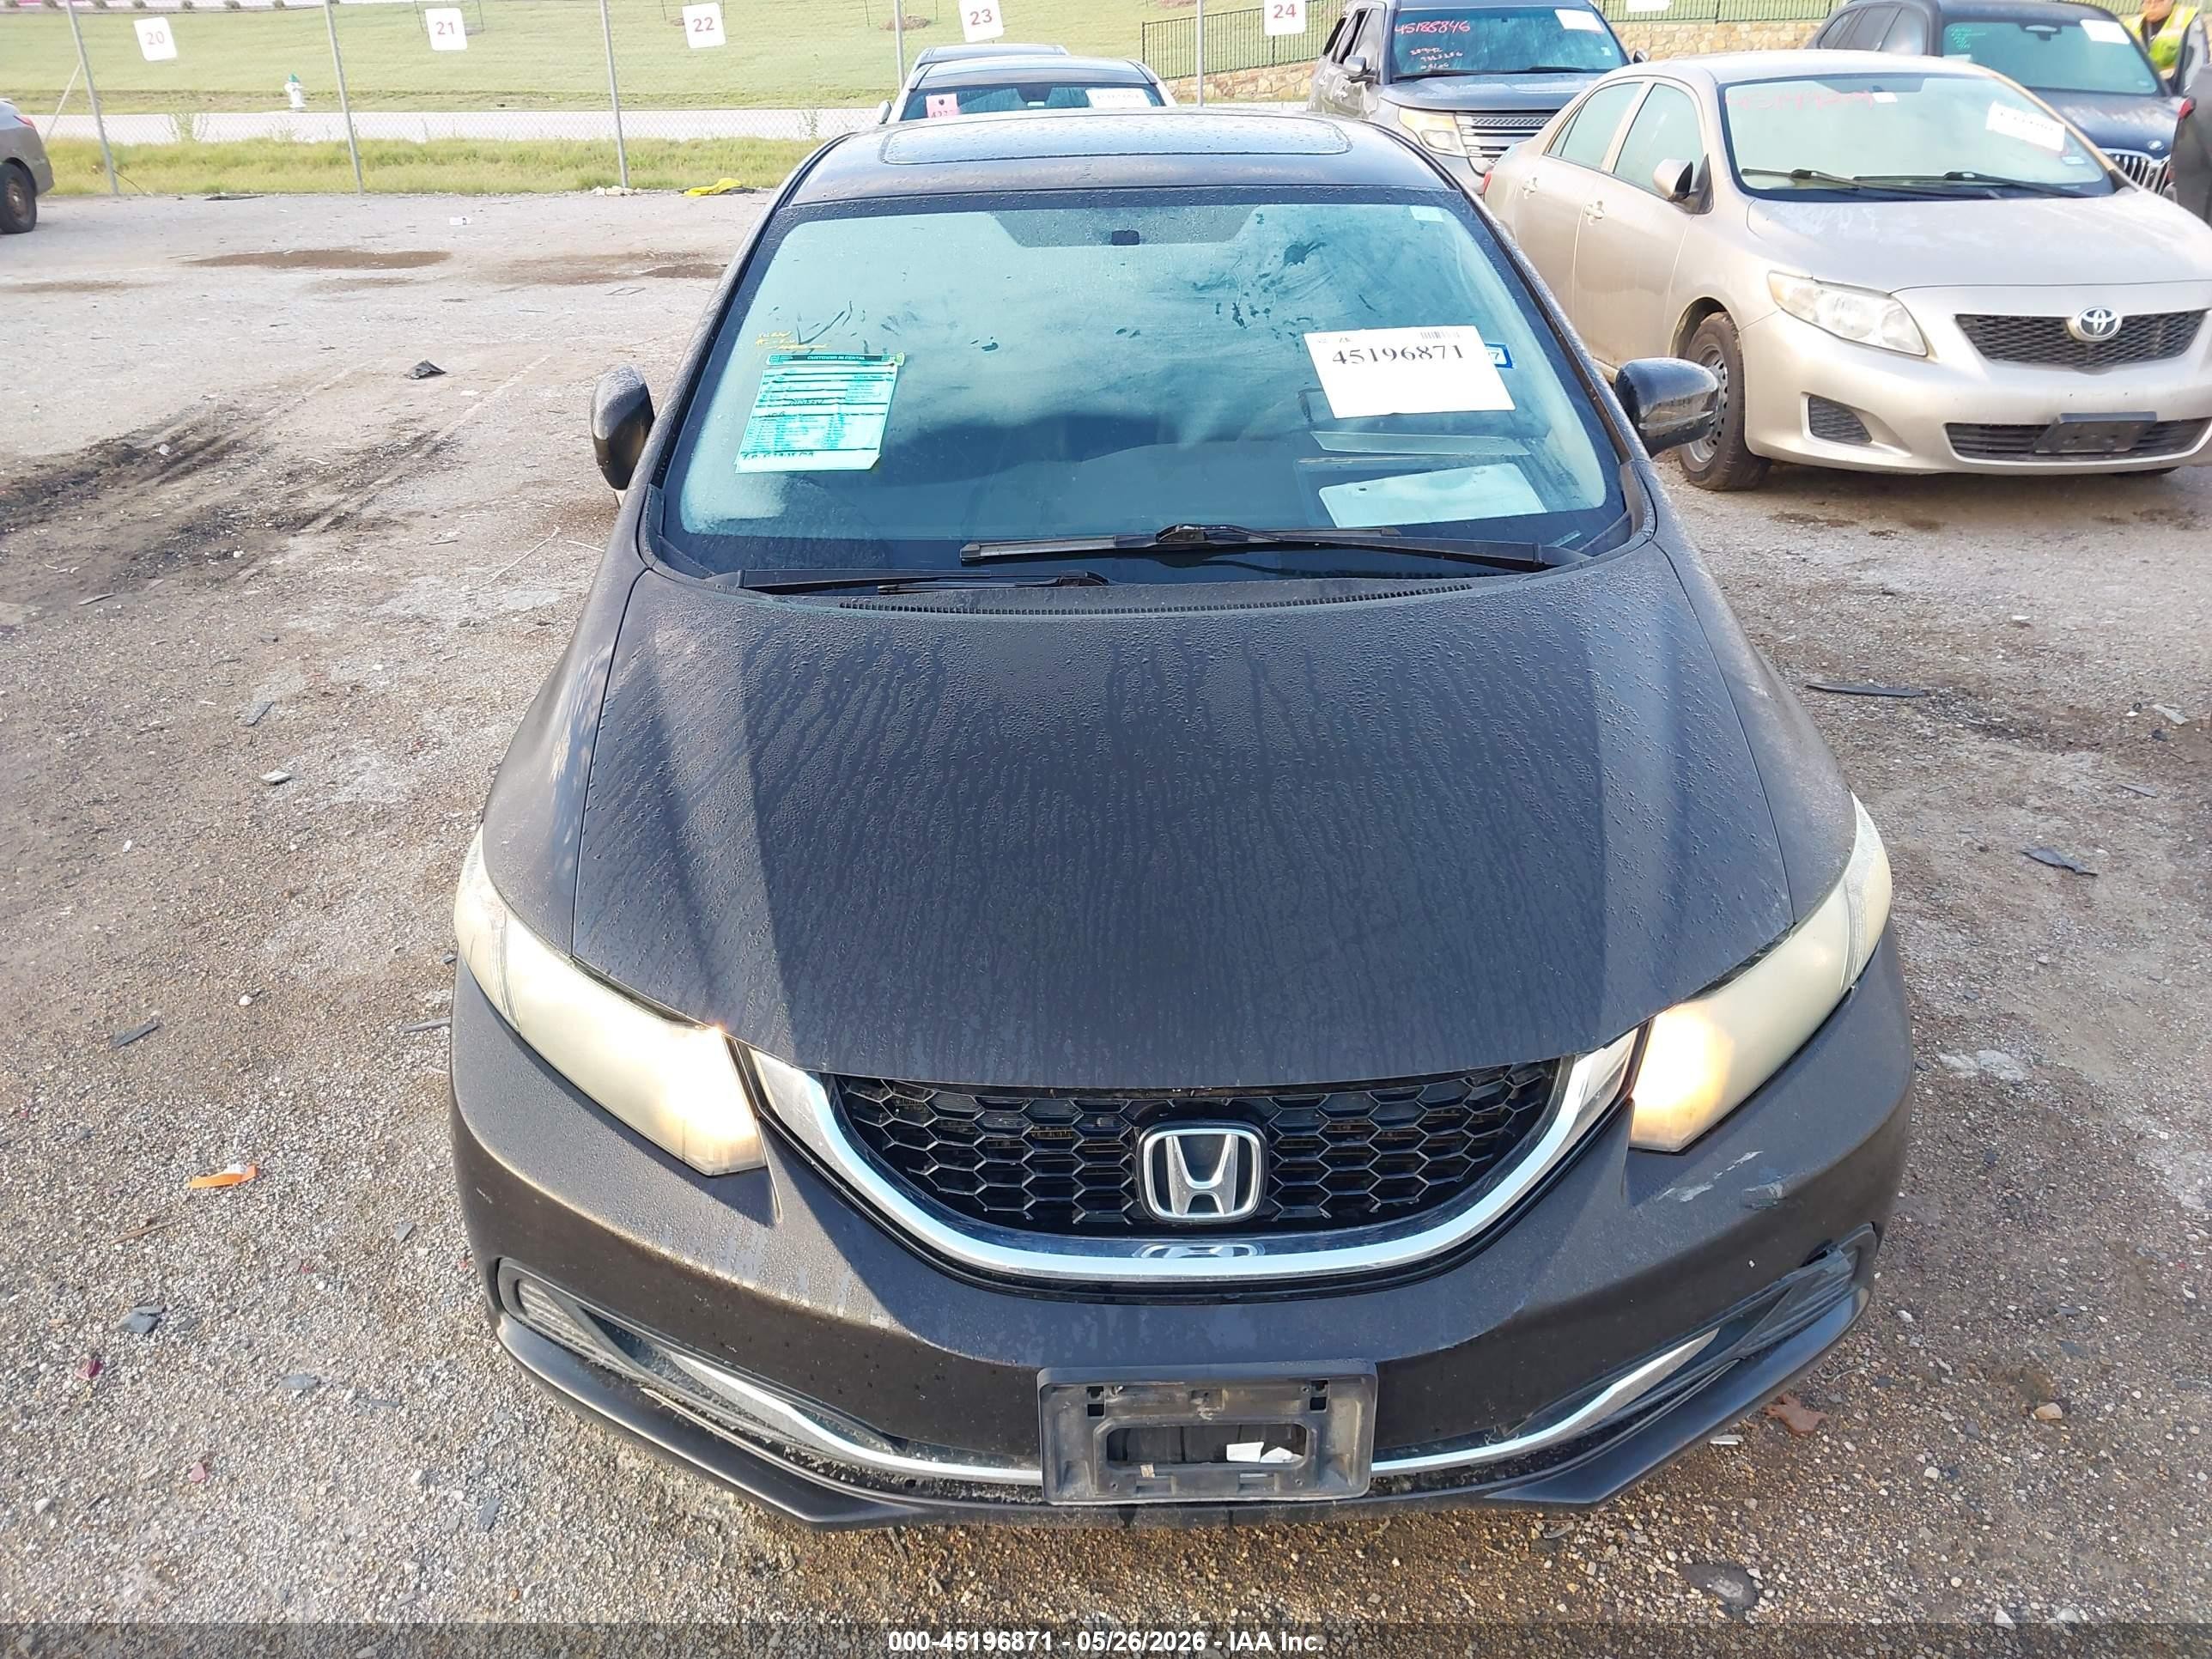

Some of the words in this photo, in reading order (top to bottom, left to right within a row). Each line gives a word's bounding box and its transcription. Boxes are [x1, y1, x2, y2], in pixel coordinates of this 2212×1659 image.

[969, 9, 993, 25] 23
[1273, 3, 1297, 18] 24
[435, 21, 454, 34] 21
[693, 17, 714, 32] 22
[145, 31, 165, 45] 20
[1333, 345, 1463, 364] 45196871
